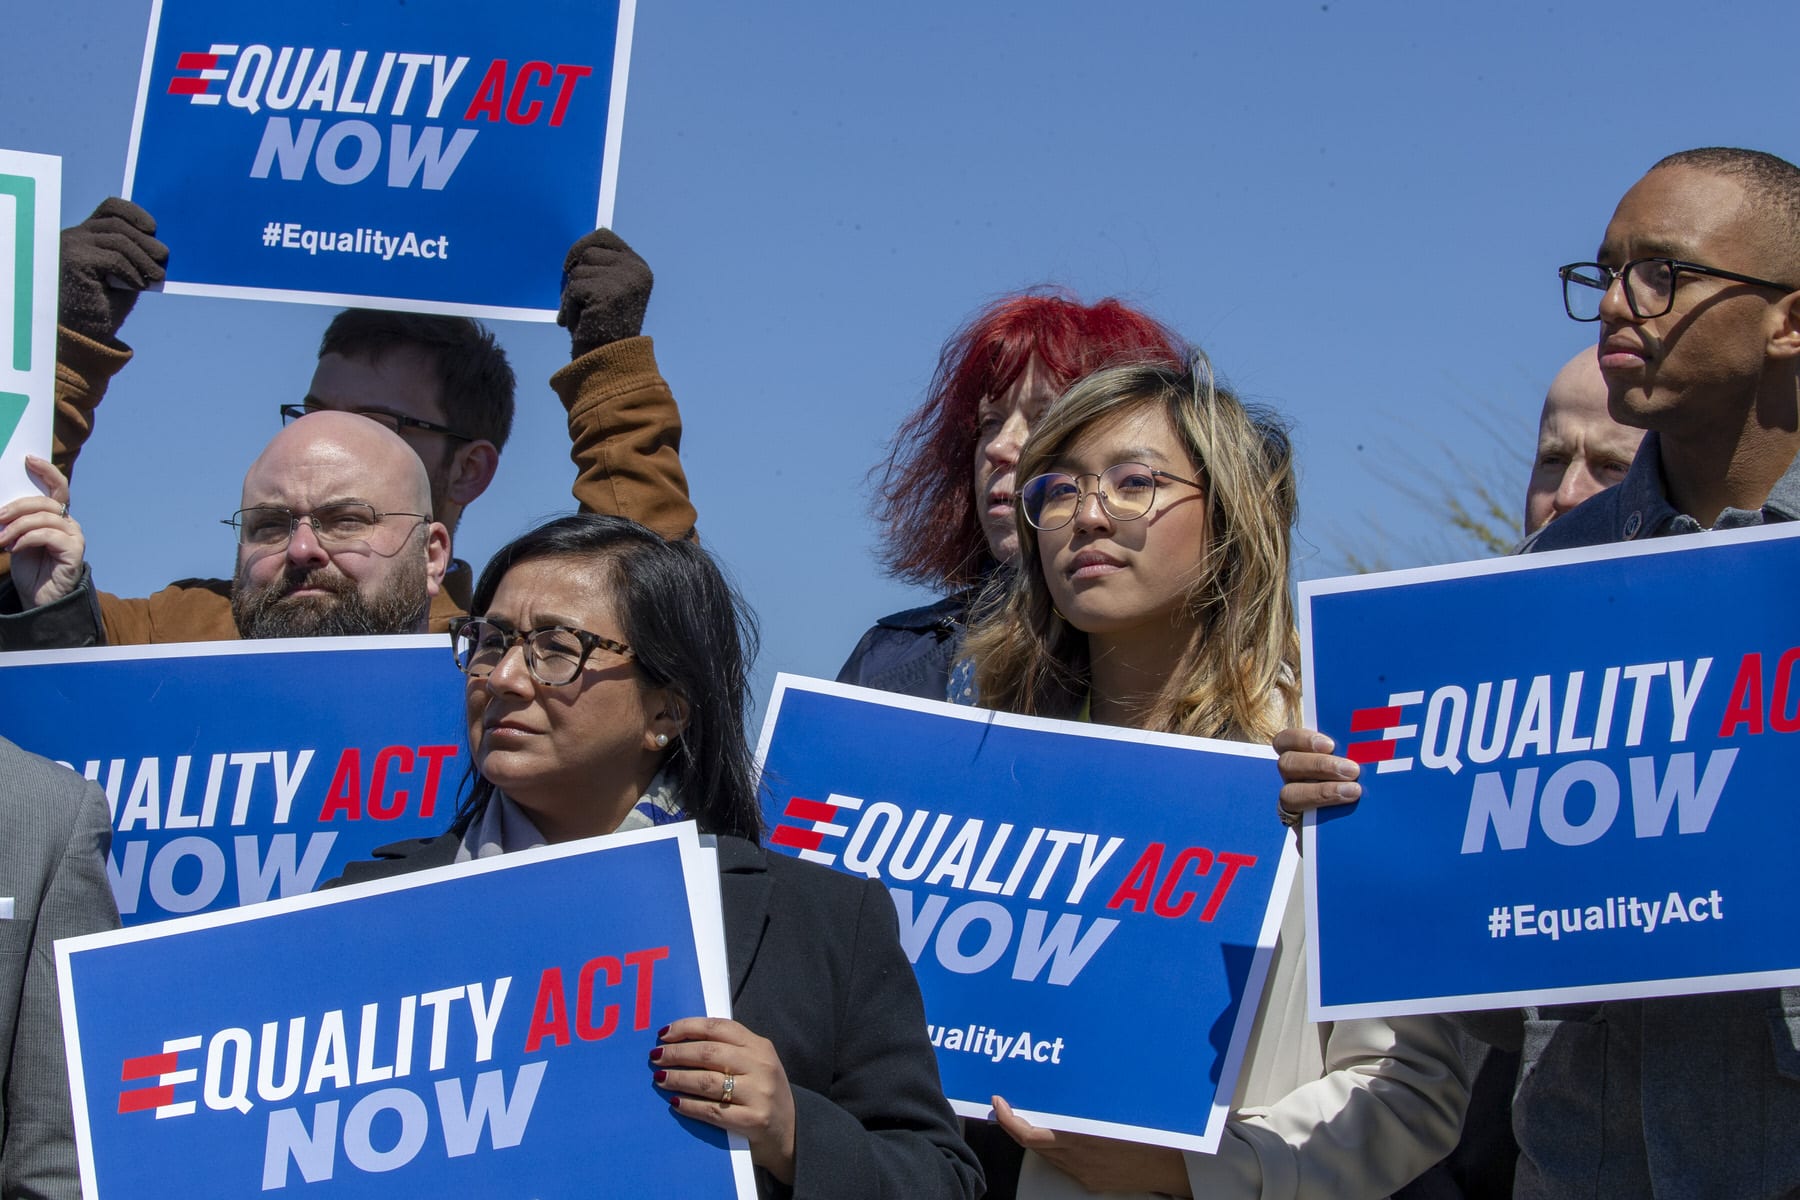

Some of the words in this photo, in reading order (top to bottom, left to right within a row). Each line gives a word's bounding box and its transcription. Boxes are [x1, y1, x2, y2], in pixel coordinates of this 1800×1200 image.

[168, 44, 470, 117] EQUALITY
[465, 59, 592, 127] ACT
[250, 117, 479, 190] NOW
[262, 222, 449, 261] #EqualityAct
[1347, 657, 1714, 775] EQUALITY
[1717, 646, 1800, 738] AC
[54, 749, 316, 832] UALITY
[318, 745, 459, 822] ACT
[1461, 748, 1740, 854] NOW
[107, 831, 339, 914] NOW
[769, 792, 1125, 905] EQUALITY
[1106, 842, 1258, 923] ACT
[888, 887, 1121, 987] NOW
[1488, 890, 1723, 941] #EqualityAct
[118, 976, 513, 1120] EQUALITY
[525, 946, 670, 1053] ACT
[928, 1023, 1065, 1075] ualityAct
[261, 1060, 548, 1191] NOW
